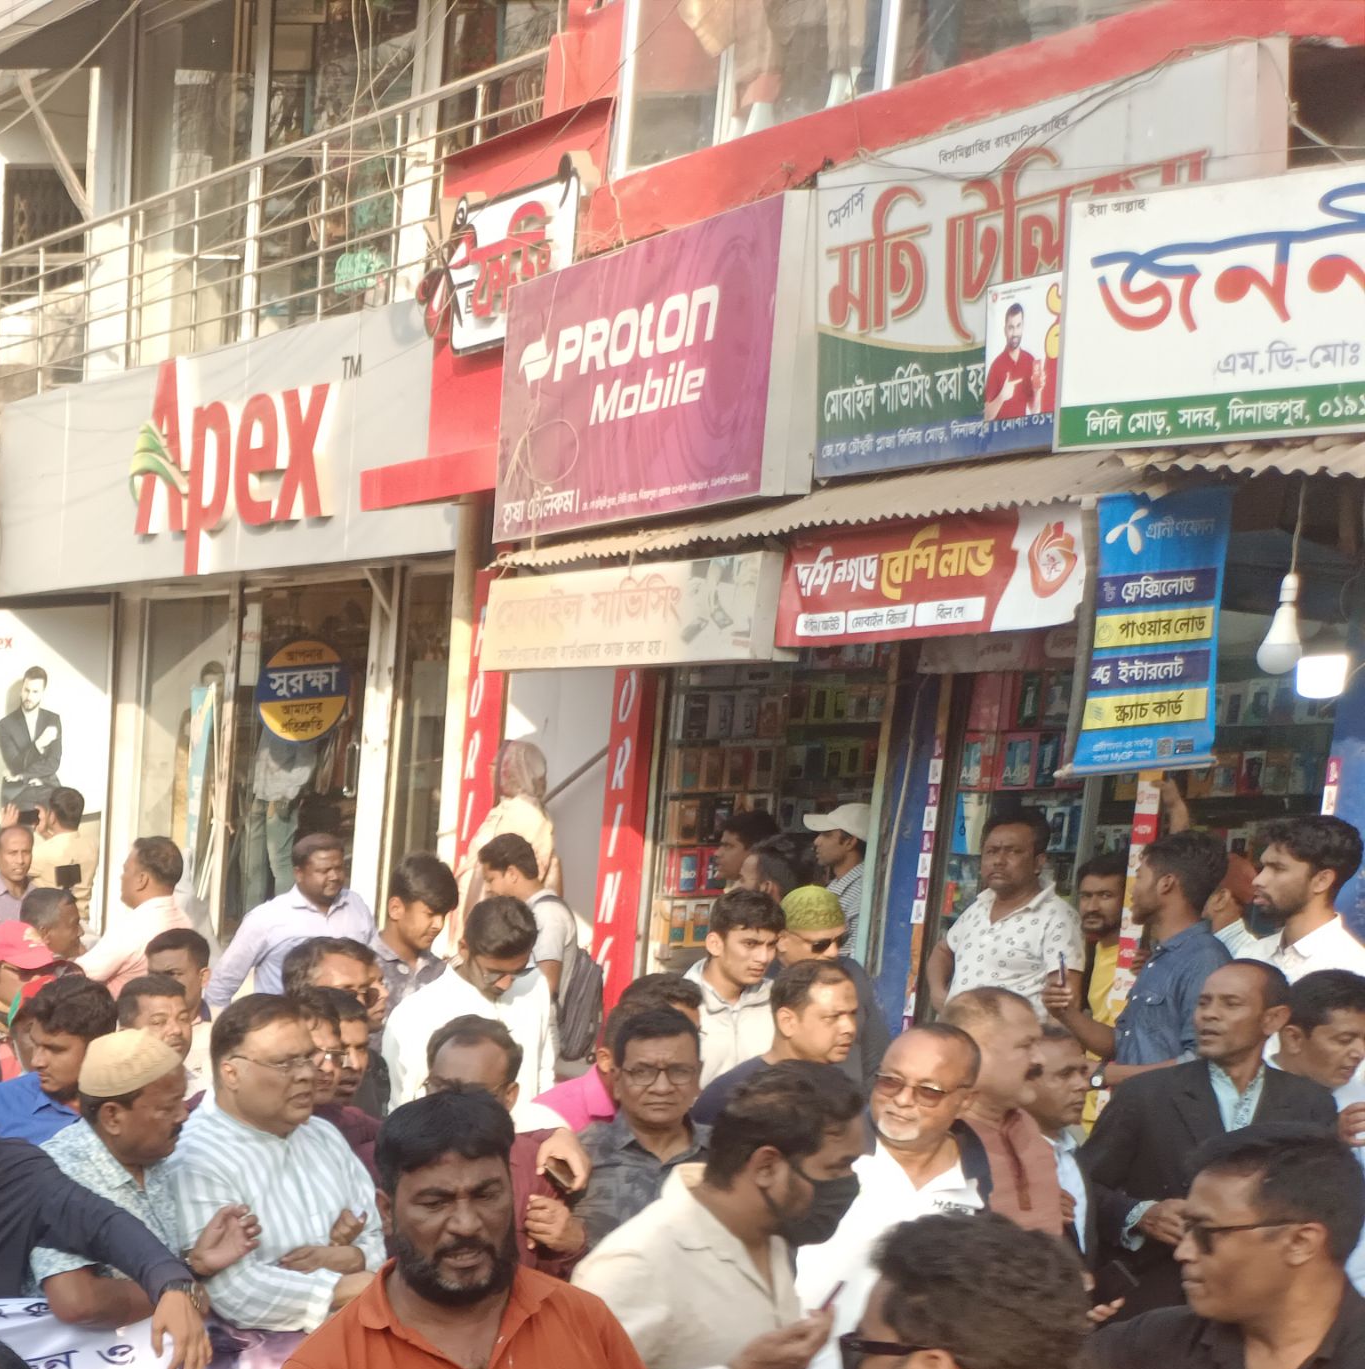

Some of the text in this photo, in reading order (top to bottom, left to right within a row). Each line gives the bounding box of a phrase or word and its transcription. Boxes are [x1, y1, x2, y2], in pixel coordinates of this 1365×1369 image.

[825, 183, 931, 335] মতি
[341, 355, 362, 379] TM
[589, 362, 705, 425] Mobile
[824, 375, 876, 423] মোবাইল
[879, 362, 933, 414] সার্ভিসিং
[935, 364, 962, 403] করা
[1086, 409, 1120, 437] লিলি
[1128, 409, 1171, 435] মোড়,
[1179, 406, 1220, 430] সদর,
[1227, 397, 1310, 425] দিনাজপুর,
[130, 358, 331, 575] Apex
[880, 524, 942, 600] বেশি
[939, 538, 996, 577] লাভ
[1119, 614, 1206, 639] পাওয়ার লোড
[267, 664, 341, 698] সুরক্ষা
[1118, 656, 1184, 683] ইন্টারনেট
[1152, 692, 1184, 717] কার্ড
